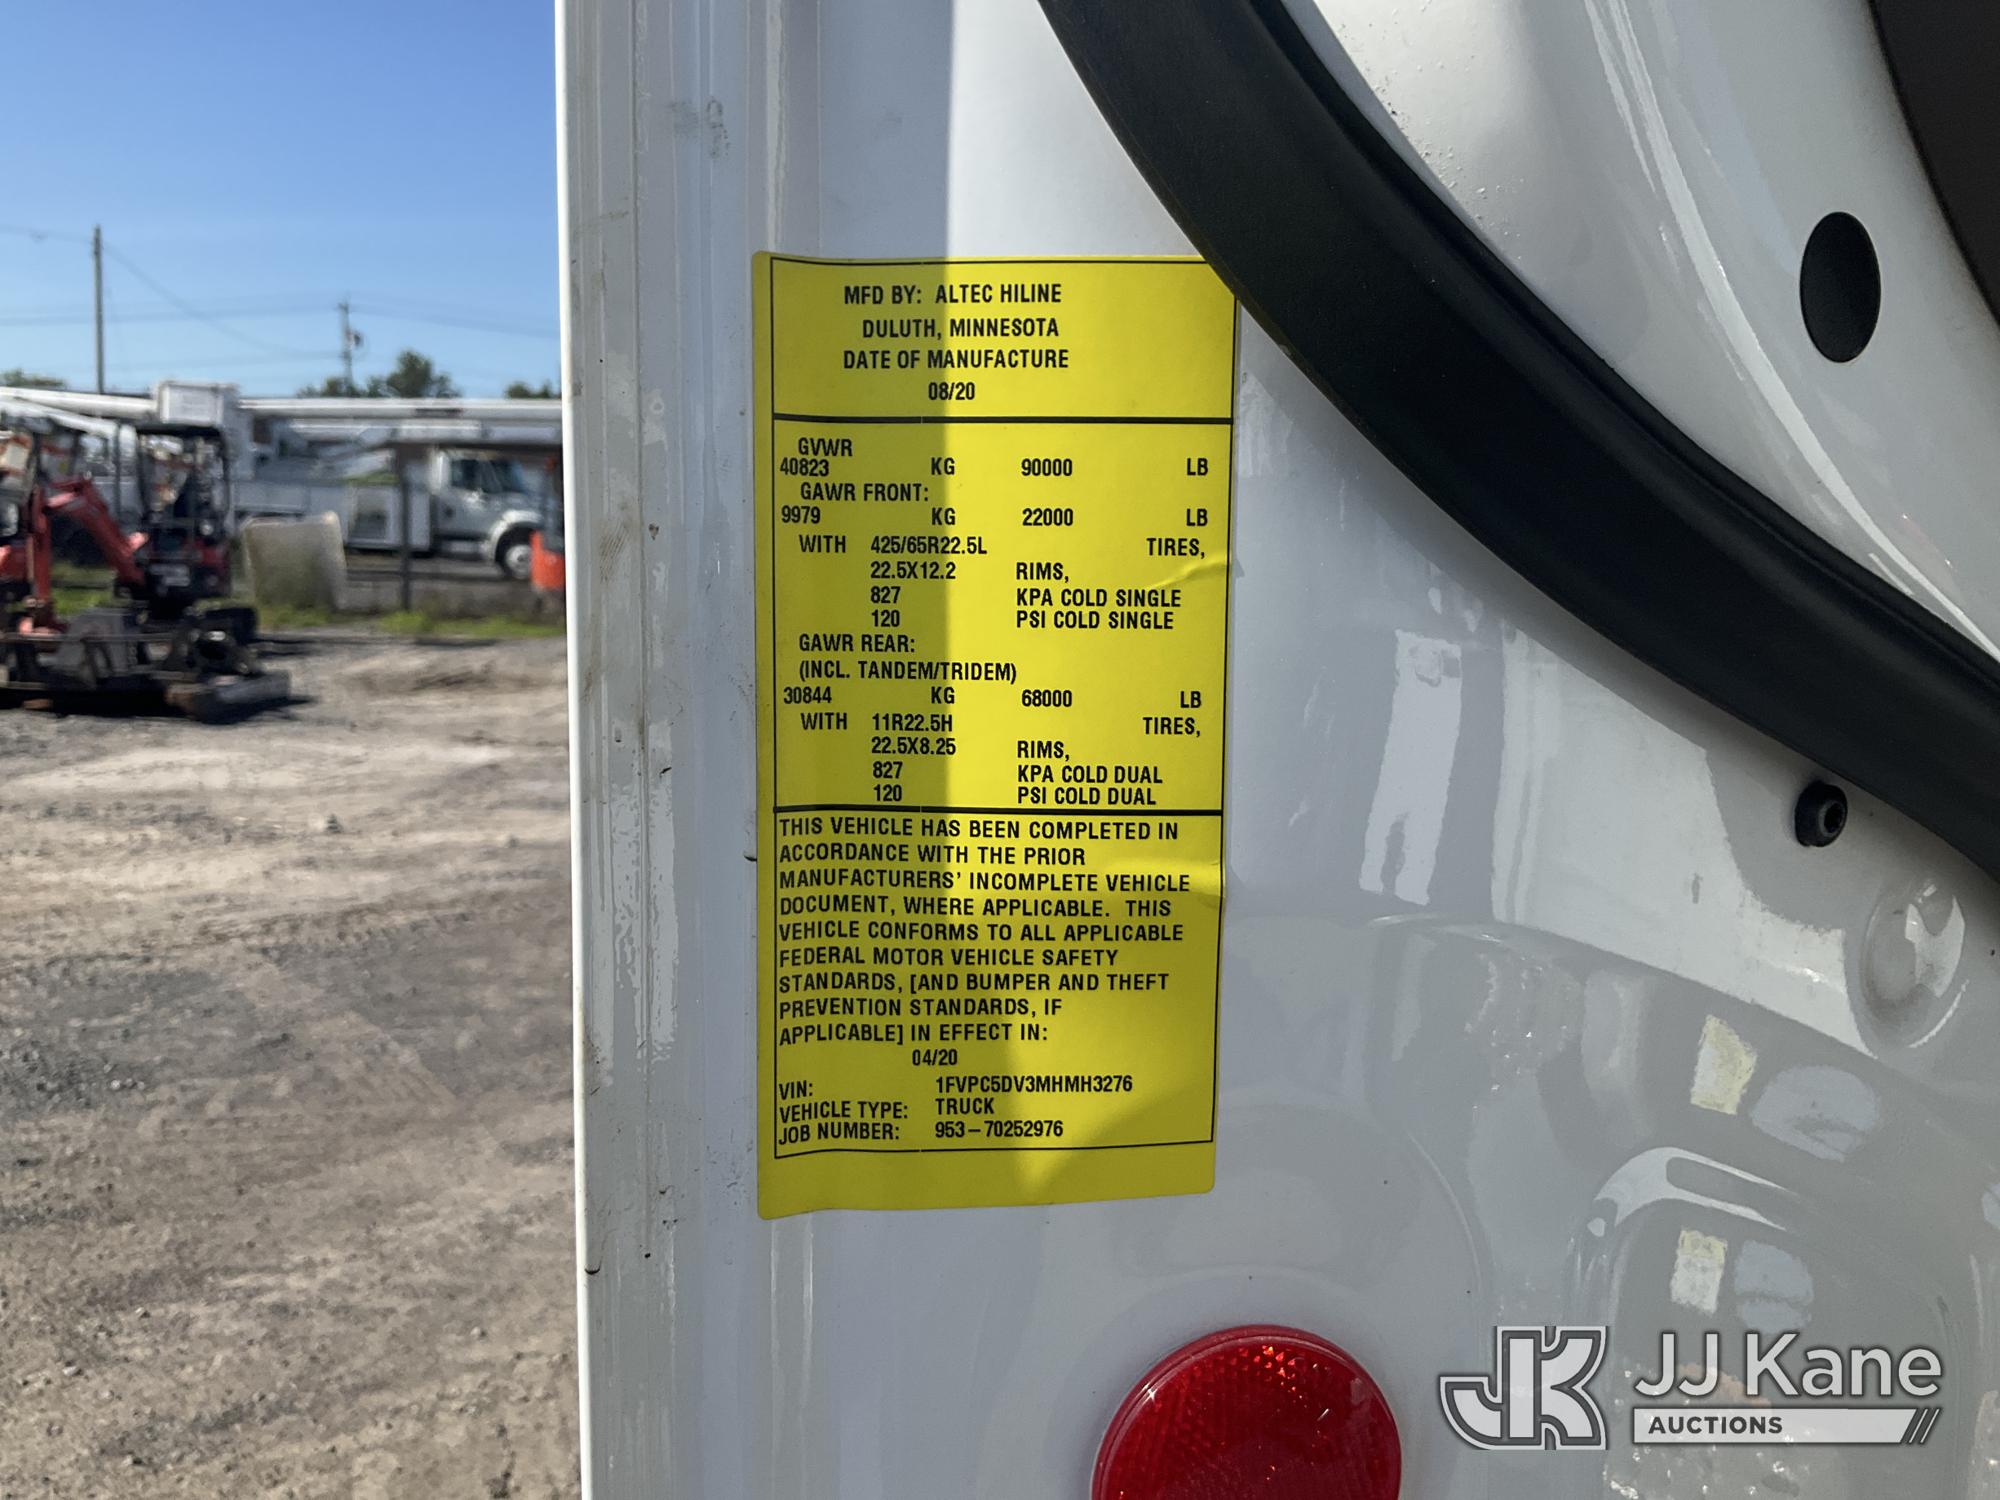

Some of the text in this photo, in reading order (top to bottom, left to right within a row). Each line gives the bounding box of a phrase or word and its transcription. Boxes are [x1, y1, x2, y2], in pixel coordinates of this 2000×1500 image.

[844, 283, 1061, 304] MFD BY: ALTEC HILINE
[863, 318, 1059, 340] DULUTH, MINNESOTA
[844, 349, 1069, 369] DATE OF MANUFACTURE
[928, 382, 975, 400] 08/20
[798, 437, 852, 457] GVWR
[780, 456, 1209, 477] 40823 KG 90000 LB
[801, 482, 928, 501] GAWR FRONT:
[782, 505, 1208, 527] 9979 KG 22000 LB
[799, 535, 1205, 559] WITH 425/65R22.5L TIRES,
[871, 561, 1069, 583] 22.5X12.2 RIMS,
[871, 586, 1181, 607] 827 KPA COLD SINGLE
[872, 610, 1173, 630] 120 PSI COLD SINGLE
[799, 633, 915, 652] GAWR REAR:
[800, 661, 1017, 685] (INCL. TANDEM/TRIDEM)
[784, 686, 1202, 708] 30844 KG 68000 LB
[801, 712, 1201, 738] WITH 11R22.5H TIRES,
[871, 736, 1069, 761] 22.5X8.25 RIMS,
[873, 761, 1163, 784] 827 KPA COLD DUAL
[874, 784, 1156, 805] 120 PSI COLD DUAL
[780, 817, 1178, 840] THIS VEHICLE HAS BEEN COMPLETED IN
[780, 843, 1085, 865] ACCORDANCE WITH THE PRIOR
[970, 872, 1097, 891] INCOMPLETE
[1106, 874, 1190, 892] VEHICLE
[781, 895, 1171, 917] DOCUMENT, WHERE APPLICABLE. THIS
[779, 921, 1183, 941] VEHICLE CONFORMS TO ALL APPLICABLE
[780, 946, 1118, 967] FEDERAL MOTOR VEHICLE SAFETY
[780, 972, 902, 993] STANDARDS,
[967, 974, 1050, 990] BUMPER
[1058, 974, 1099, 991] AND
[1107, 973, 1169, 990] THEFT
[780, 998, 1062, 1019] PREVENTION STANDARDS, IF
[911, 1025, 930, 1041] IN
[940, 1023, 1012, 1041] EFFECT
[1021, 1024, 1047, 1041] IN:
[912, 1049, 957, 1066] 04/20
[779, 1075, 1133, 1100] VIN: 1FVPC5DV3MHMH3276
[780, 1098, 994, 1123] VEHICLE TYPE: TRUCK
[779, 1125, 810, 1145] JOB
[818, 1122, 899, 1140] NUMBER:
